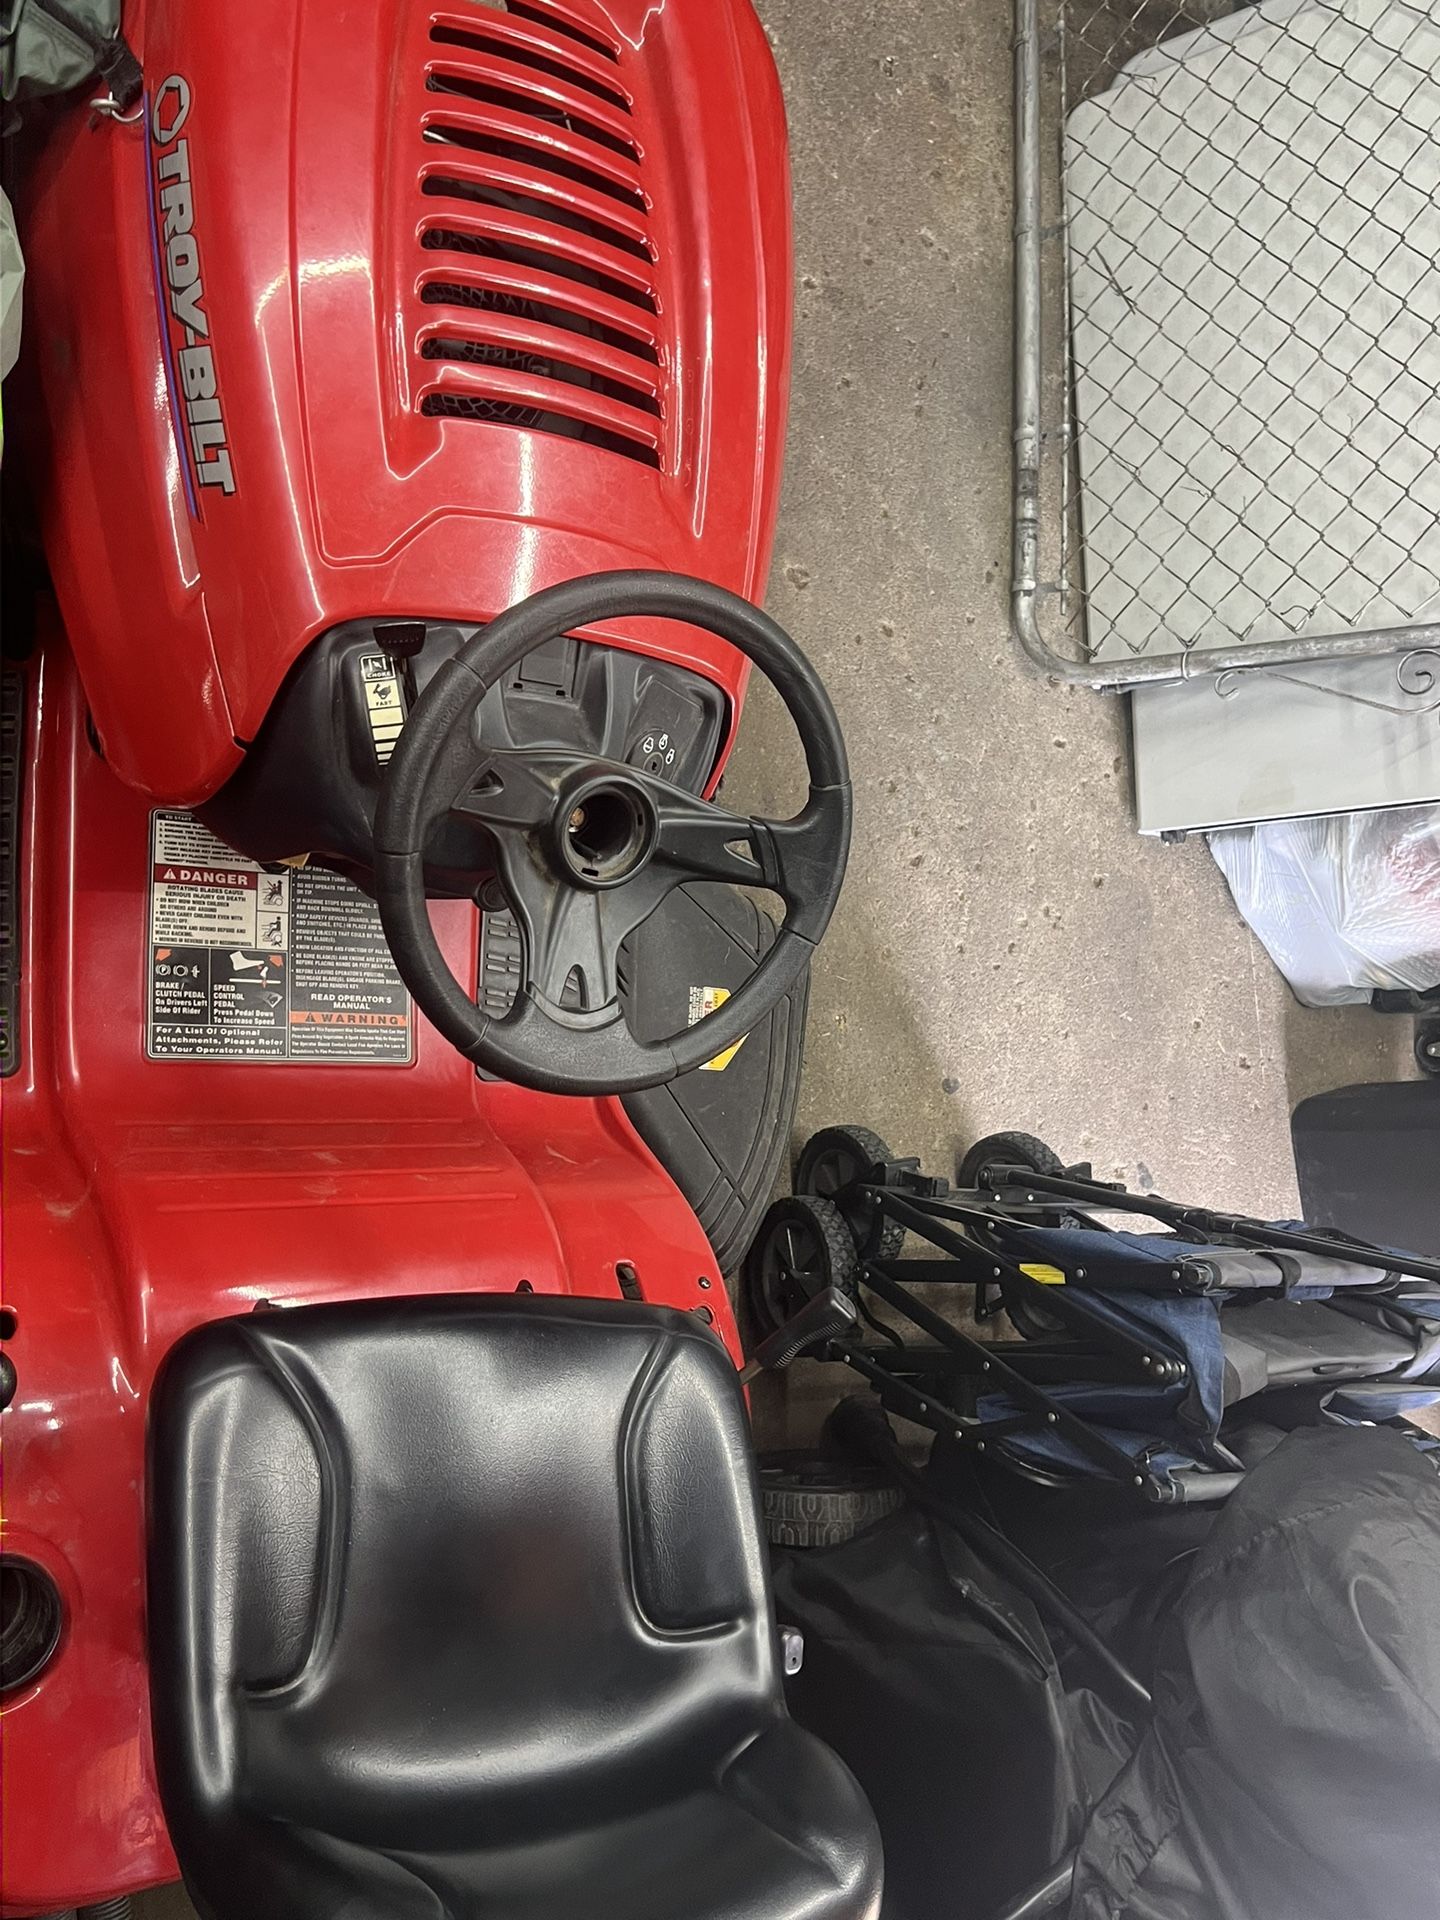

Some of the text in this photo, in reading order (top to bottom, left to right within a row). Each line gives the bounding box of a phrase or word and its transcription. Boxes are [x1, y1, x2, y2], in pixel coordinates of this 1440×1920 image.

[158, 138, 237, 496] TROY-BILT
[180, 870, 248, 885] DANGER
[156, 982, 180, 990] BRAKE
[184, 990, 205, 998] PEDAL
[214, 992, 245, 1000] CONTROL
[338, 994, 392, 1004] OPERATOR'S
[156, 1006, 171, 1014] Side
[182, 1006, 200, 1014] Rider
[334, 1002, 370, 1010] MANUAL
[223, 1016, 254, 1024] Increase
[321, 1014, 398, 1025] WARNING
[220, 1028, 260, 1036] Optional
[156, 1036, 222, 1044] Attachments,
[196, 1046, 244, 1054] Operators
